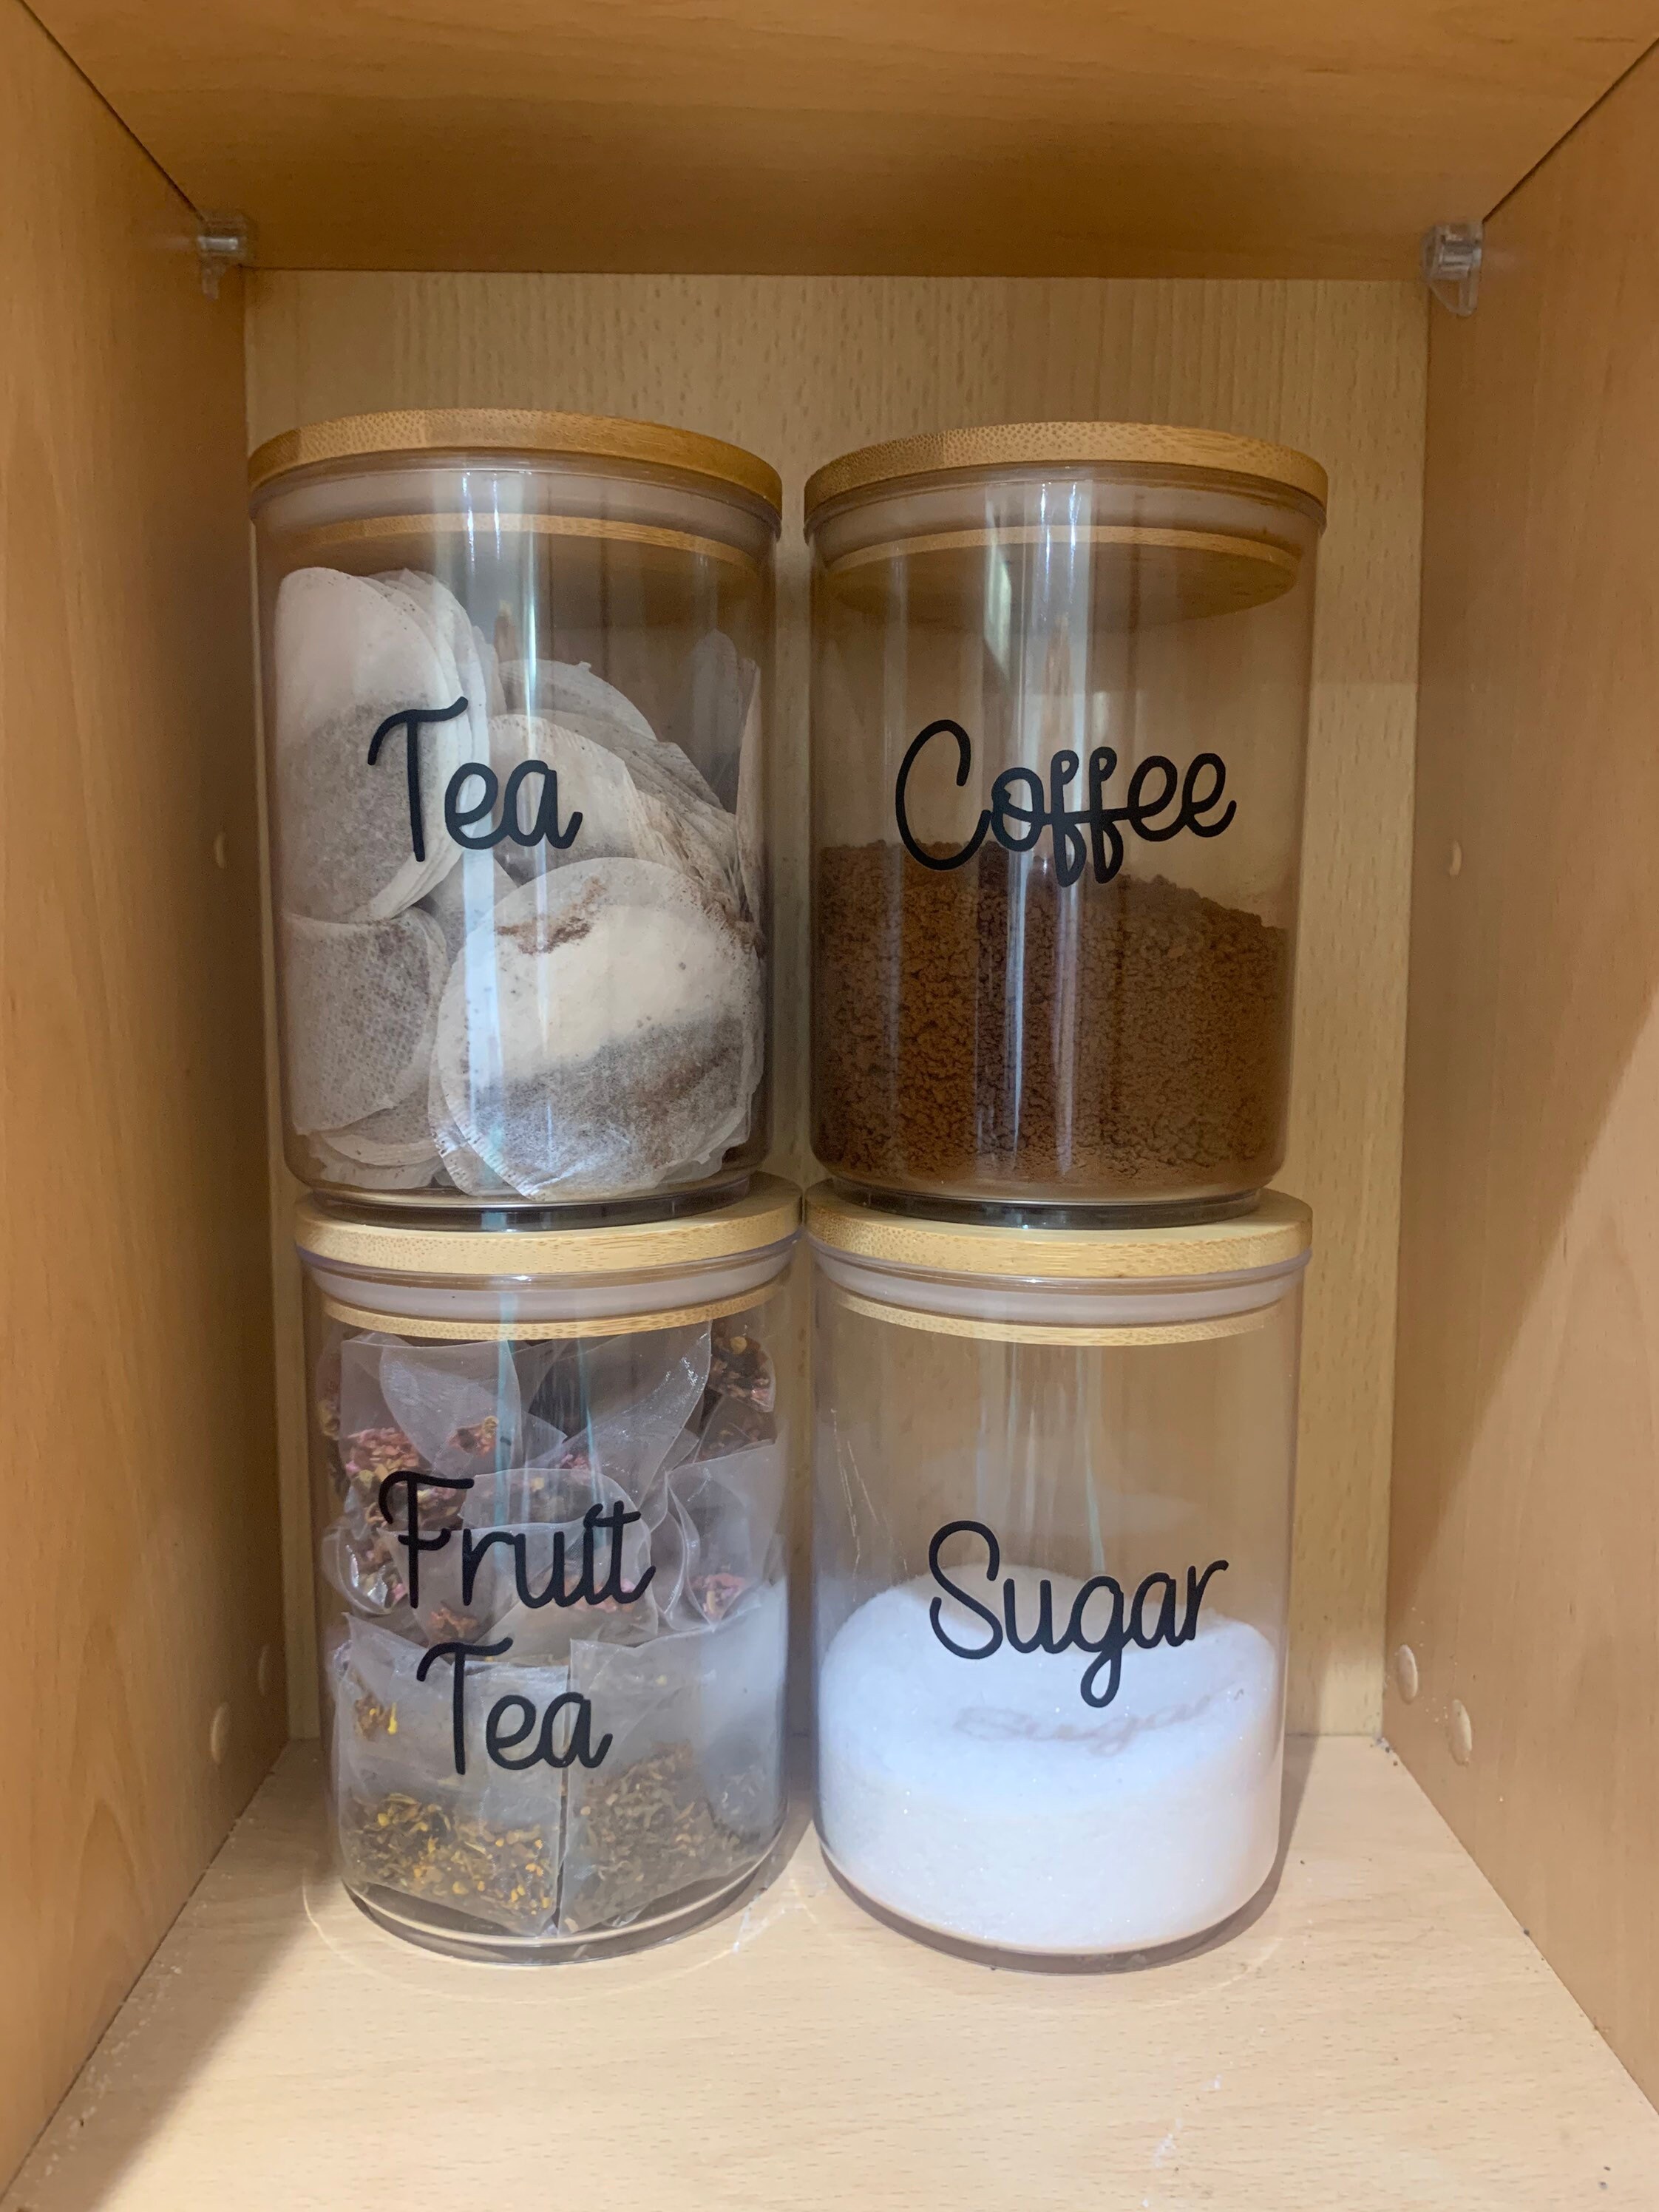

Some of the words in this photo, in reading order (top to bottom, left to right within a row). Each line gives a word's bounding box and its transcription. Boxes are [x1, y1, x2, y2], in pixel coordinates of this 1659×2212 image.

[367, 696, 583, 863] Tea
[895, 719, 1238, 888] Coffee
[377, 1470, 657, 1609] Fruit
[928, 1519, 1229, 1709] Sugar
[416, 1636, 613, 1776] Tea
